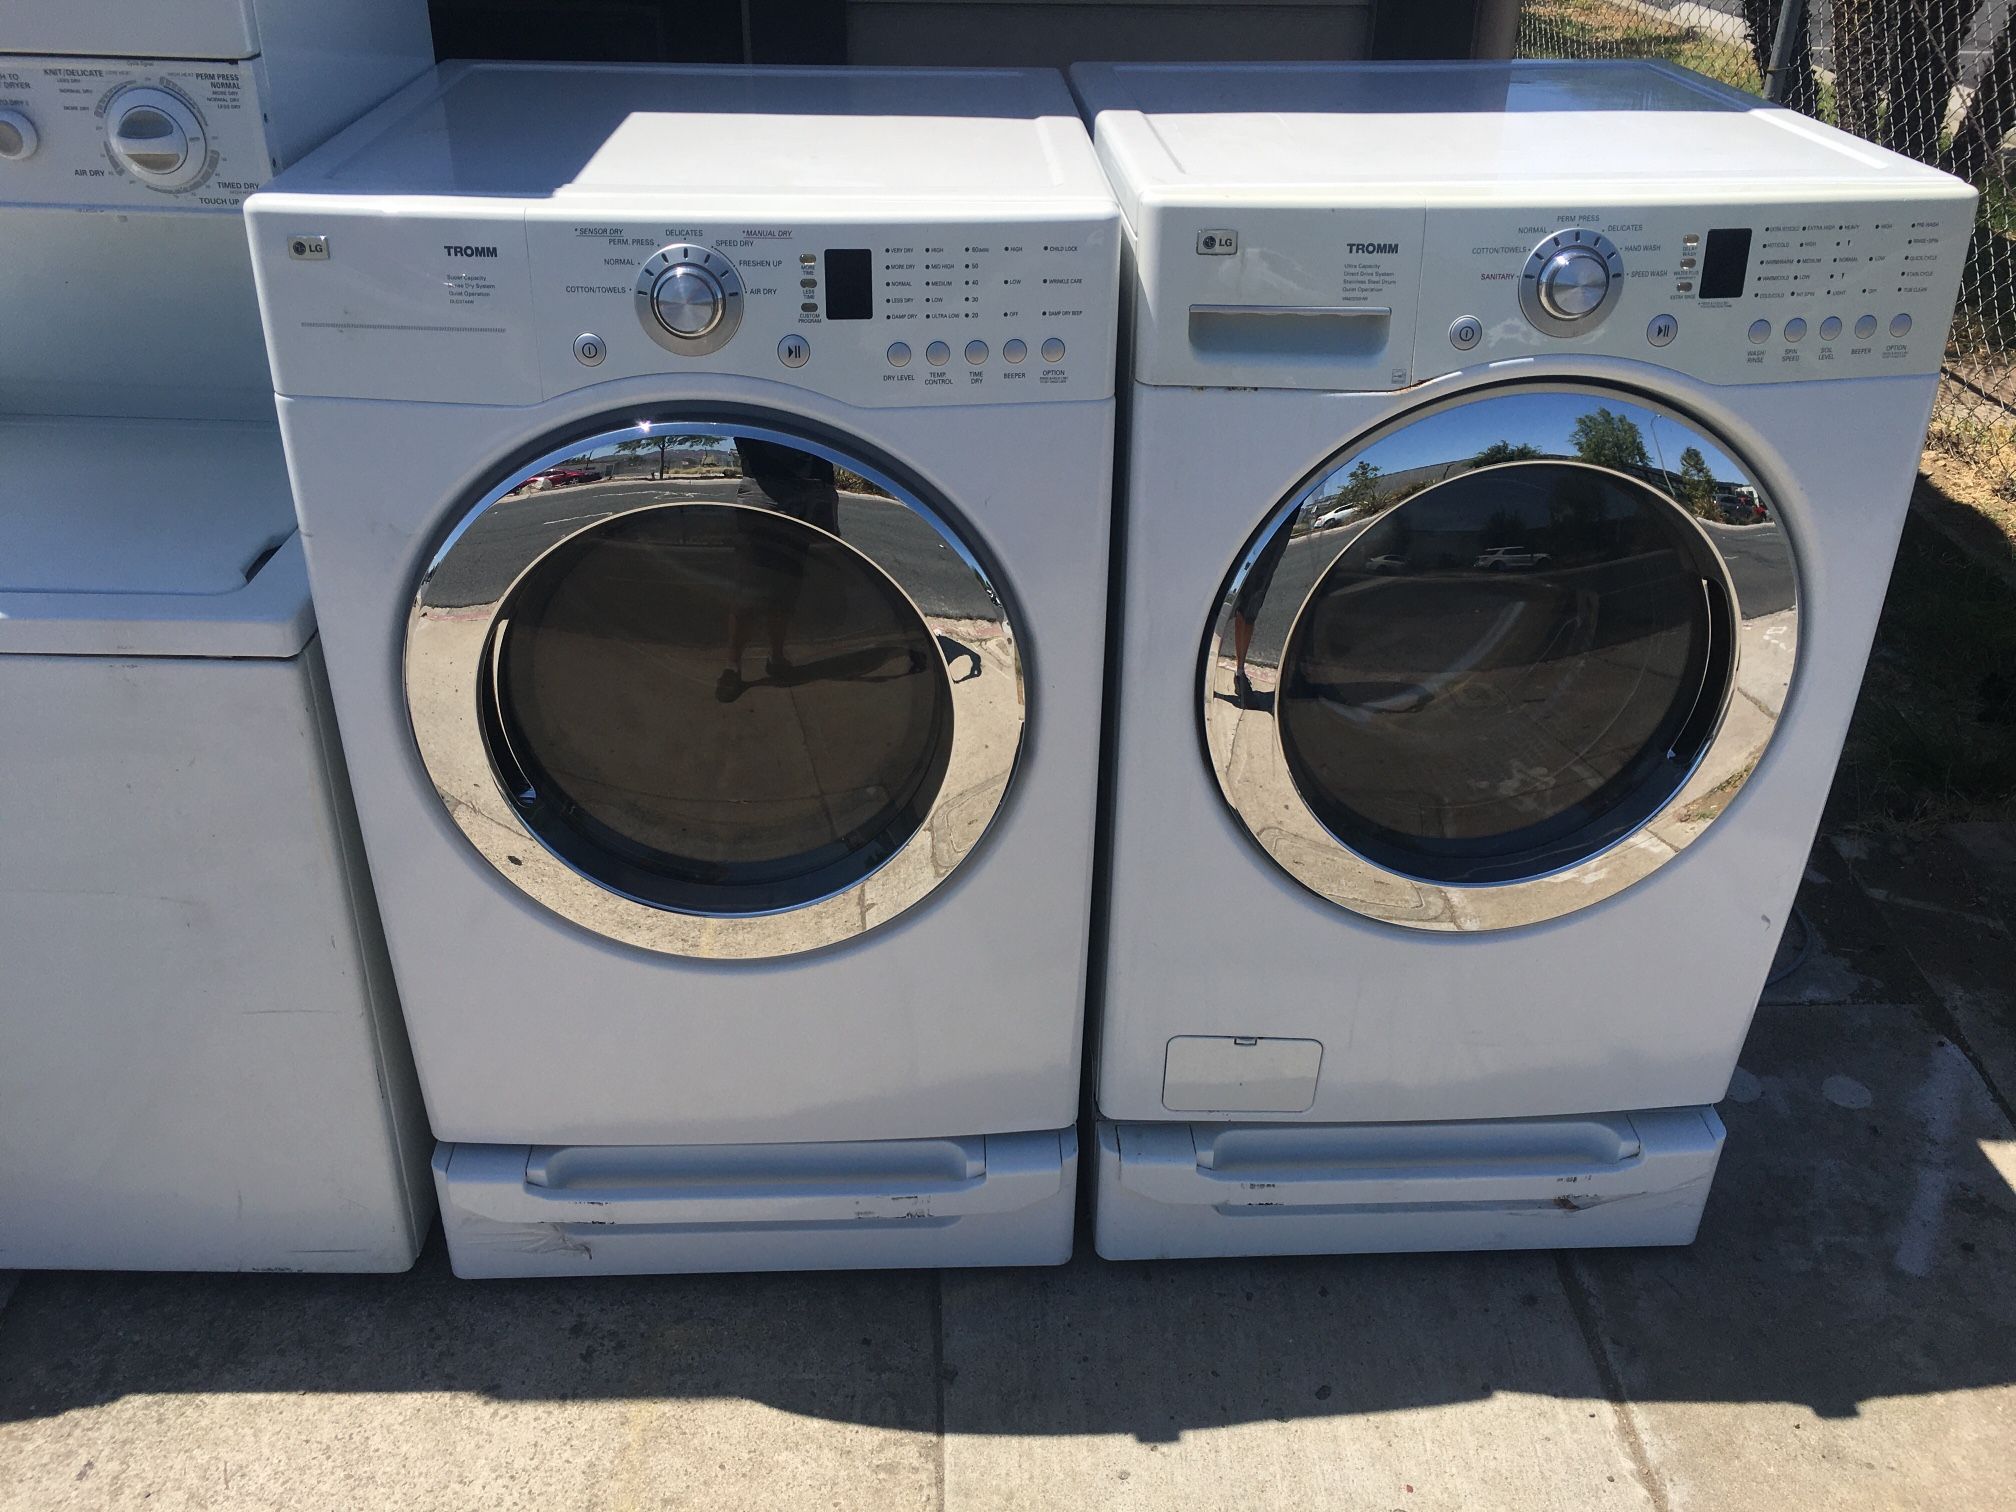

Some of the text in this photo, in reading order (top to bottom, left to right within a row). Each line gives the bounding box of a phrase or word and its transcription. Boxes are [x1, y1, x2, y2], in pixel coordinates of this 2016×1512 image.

[43, 68, 104, 77] KNIT/DELICATE
[195, 73, 216, 81] PERM
[217, 73, 239, 81] PRESS
[4, 81, 31, 89] DRYER
[210, 82, 241, 90] NORMAL
[74, 169, 105, 177] AIR DRY
[217, 181, 260, 190] TIMED DRY
[199, 197, 240, 206] TOUCH UP
[1518, 226, 1548, 234] NORMAL
[1607, 224, 1643, 232] DELICATES
[665, 229, 703, 237] DELICATES
[745, 229, 793, 238] MANUAL DRY
[608, 238, 630, 246] PERM.
[715, 239, 737, 247] SPEED
[1219, 238, 1233, 247] LG
[309, 244, 323, 253] LG
[444, 245, 499, 258] TROMM
[1346, 242, 1399, 254] TROMM
[1471, 246, 1527, 254] COTTON/TOWELS
[1624, 244, 1661, 252] HAND WASH
[604, 258, 635, 266] NORMAL
[1480, 273, 1515, 281] SANITARY
[1650, 270, 1668, 278] WASH
[565, 286, 627, 294] COTTON/TOWELS
[763, 288, 777, 296] DRY
[1003, 372, 1026, 380] BEEPER
[1042, 369, 1065, 377] OPTION
[924, 378, 954, 386] CONTROL
